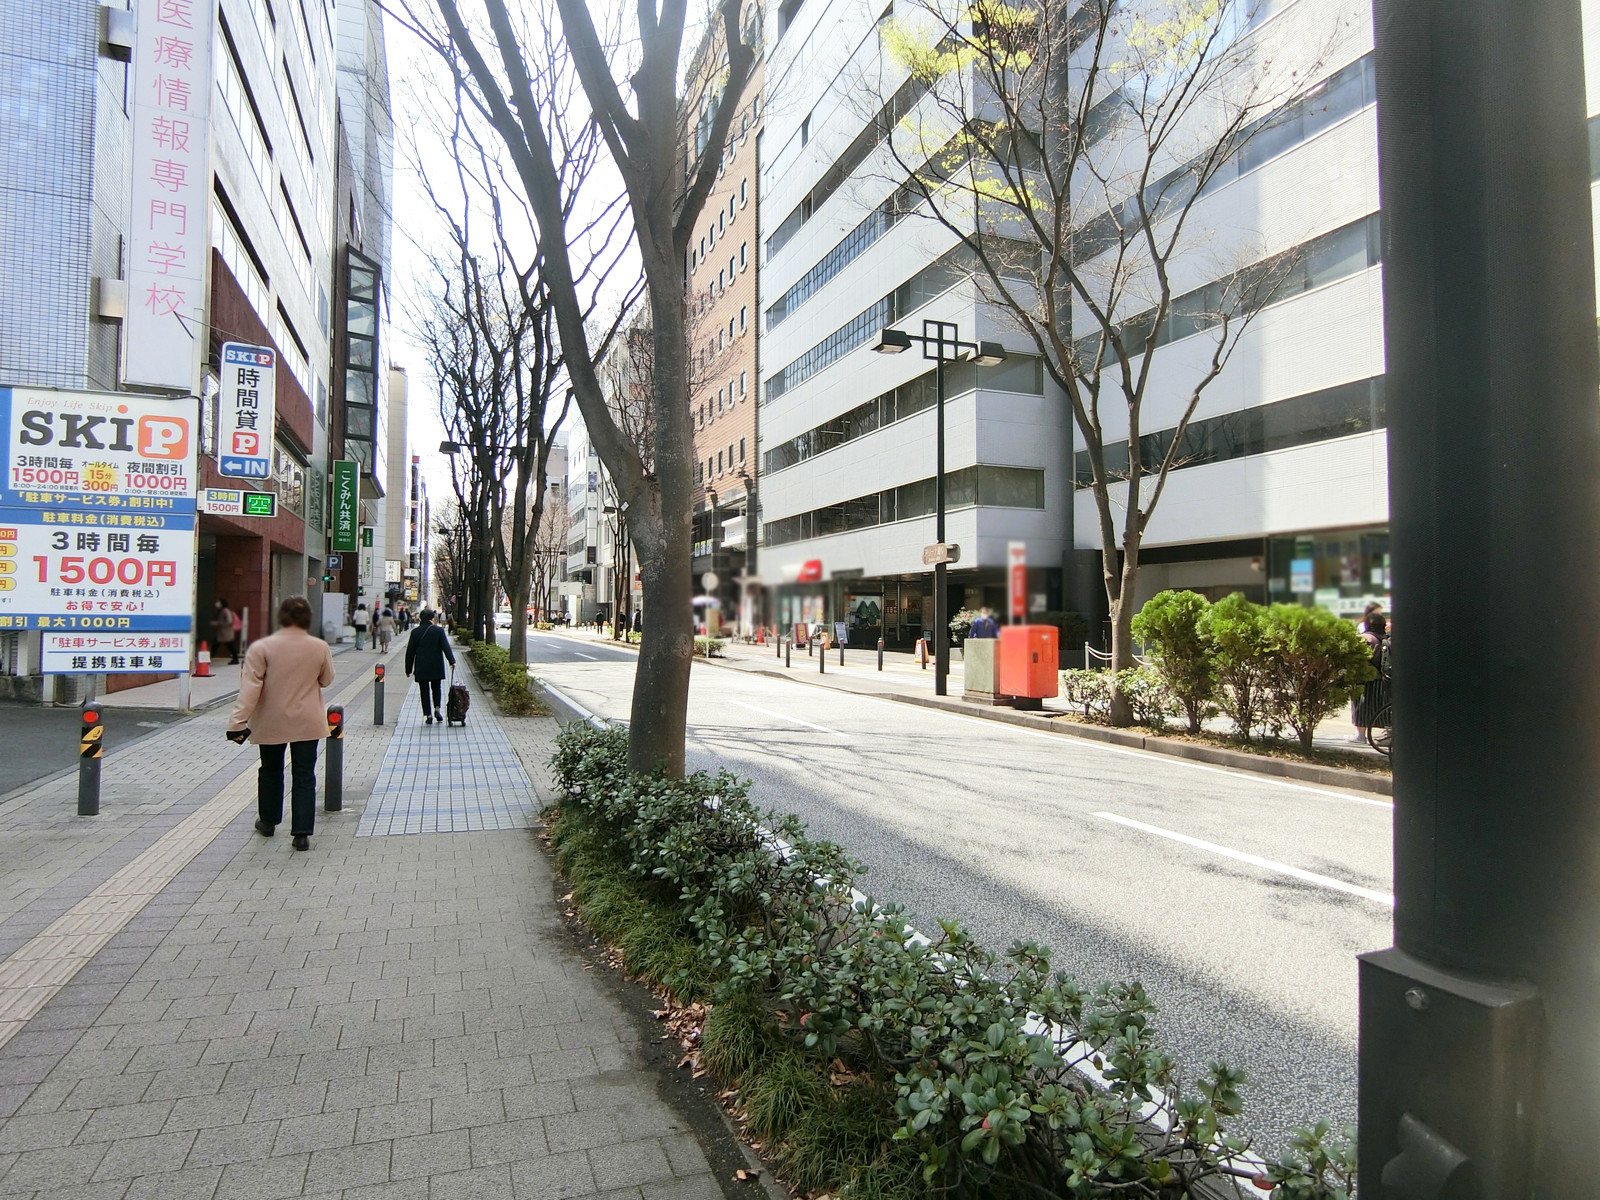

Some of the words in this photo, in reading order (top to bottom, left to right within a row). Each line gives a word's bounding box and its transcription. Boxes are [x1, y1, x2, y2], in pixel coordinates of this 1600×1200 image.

[144, 0, 194, 317] 医療情報専門学校
[27, 397, 58, 408] Enjoy
[63, 399, 84, 409] Life
[90, 402, 113, 412] Skip
[16, 455, 73, 469] 3時間毎
[81, 461, 119, 469] オールタイム
[127, 462, 183, 475] 夜間割引
[243, 459, 266, 475] IN
[12, 467, 79, 484] 1500円
[89, 469, 112, 480] 15分
[81, 480, 119, 492] 300円
[125, 473, 187, 490] 1000円
[209, 491, 238, 501] 3時間
[207, 503, 239, 512] 1500円
[248, 495, 271, 514] 空
[51, 531, 160, 553] 3時間毎
[329, 556, 339, 568] P
[32, 555, 177, 587] 1500円
[37, 616, 131, 628] 最大1000円
[51, 637, 184, 648] 「駐車サービス券」割引
[72, 656, 163, 669] 提携駐車場
